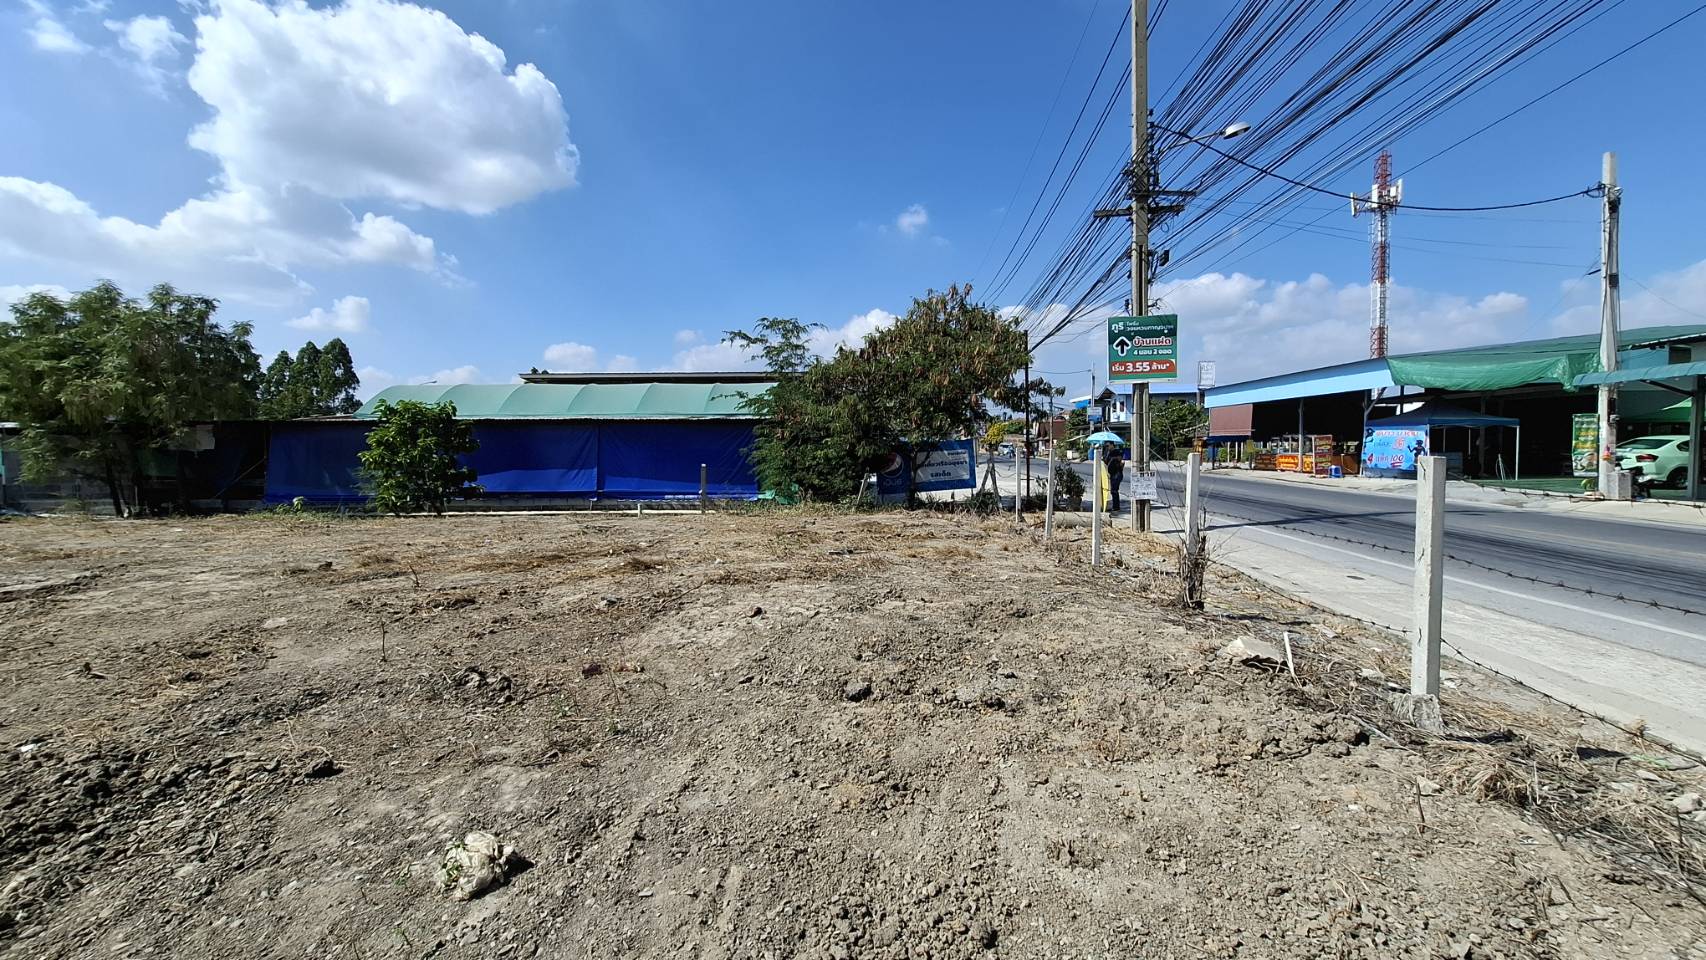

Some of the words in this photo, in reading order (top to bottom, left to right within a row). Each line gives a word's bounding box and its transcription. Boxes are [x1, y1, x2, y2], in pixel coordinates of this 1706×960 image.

[1133, 336, 1172, 346] บ้านแฝด
[1112, 362, 1125, 372] เริ่ม
[1126, 362, 1151, 372] 3.55
